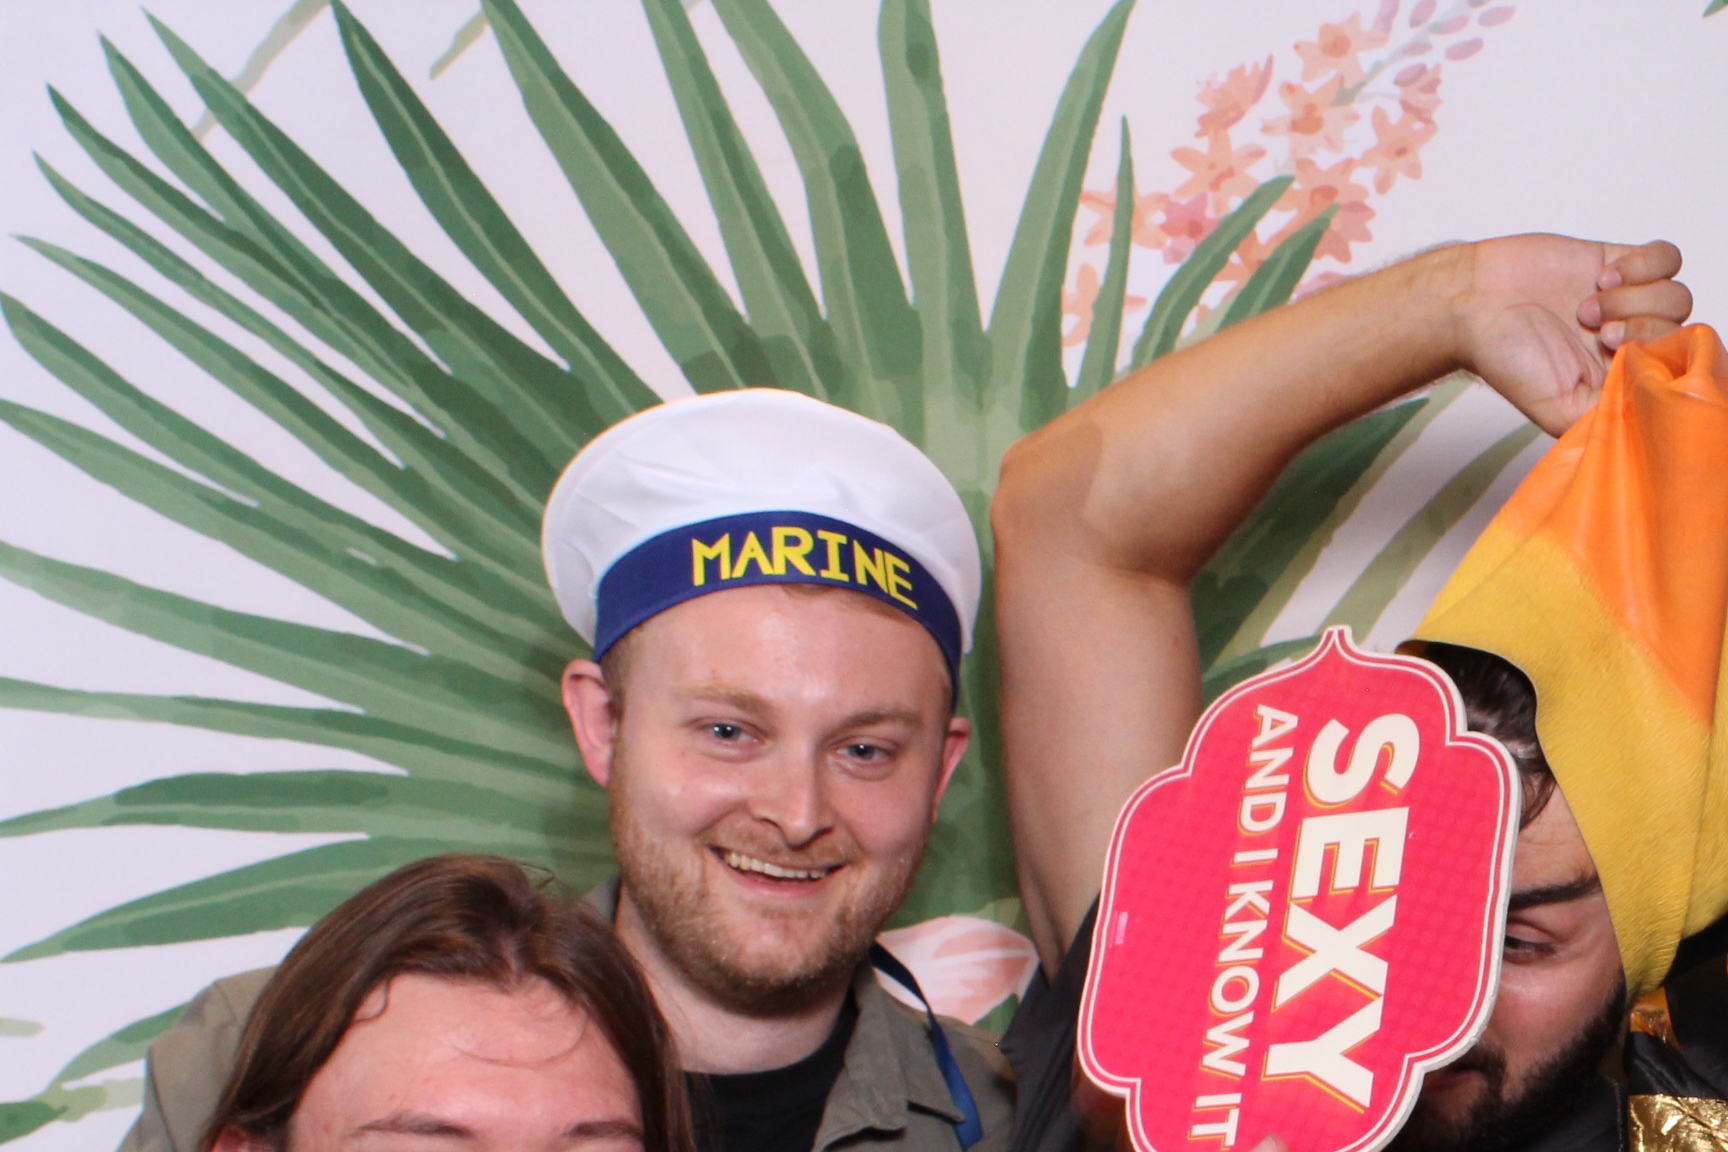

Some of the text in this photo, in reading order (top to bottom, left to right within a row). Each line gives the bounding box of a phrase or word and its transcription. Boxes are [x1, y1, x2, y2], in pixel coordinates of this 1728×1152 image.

[691, 526, 919, 610] MARINE
[1187, 703, 1299, 1151] AND I KNOW IT
[1262, 713, 1420, 1114] SEXY
